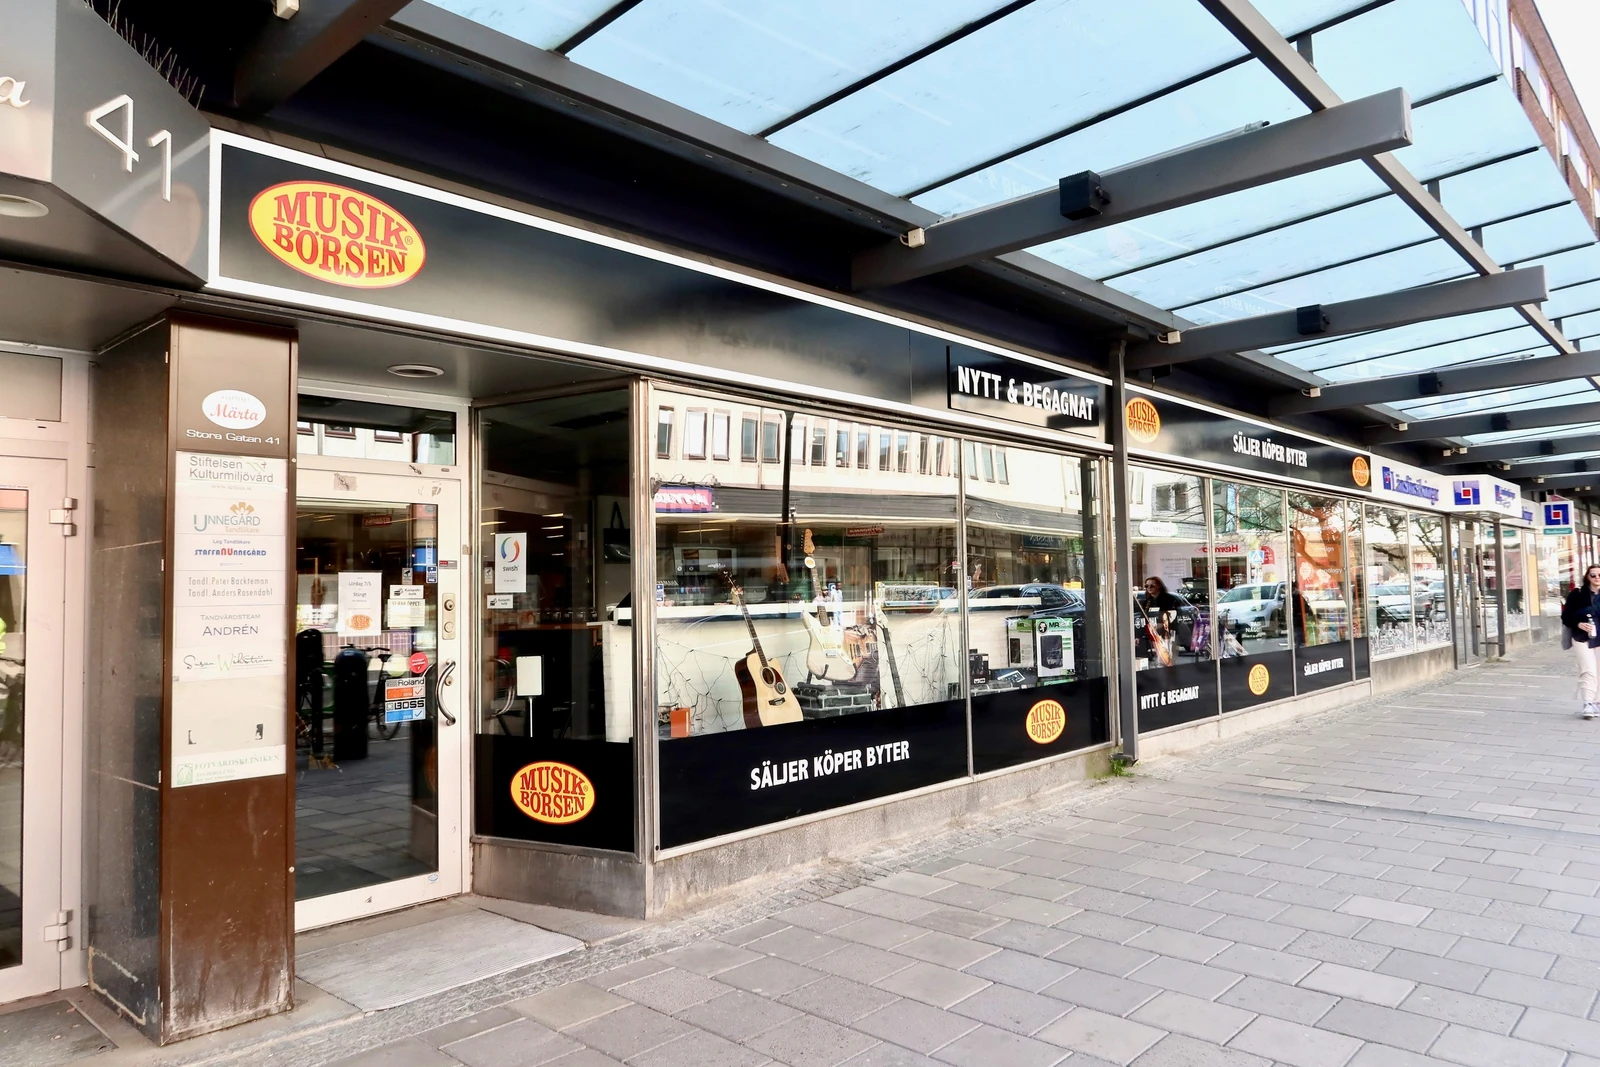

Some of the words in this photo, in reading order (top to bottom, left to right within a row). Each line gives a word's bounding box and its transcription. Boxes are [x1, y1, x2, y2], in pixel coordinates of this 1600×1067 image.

[86, 94, 172, 202] 41
[273, 191, 409, 250] MUSIK
[272, 223, 408, 279] BÖRSEN
[957, 365, 1001, 400] NYTT
[1007, 378, 1018, 404] &
[1022, 381, 1094, 421] BEGAGNAT
[209, 403, 259, 421] Märta
[1128, 401, 1156, 423] MUSIK
[186, 429, 222, 440] Stora
[225, 432, 262, 443] Gatan
[265, 436, 280, 445] 41
[1233, 431, 1260, 457] SÄLJER
[1262, 438, 1285, 463] KÖPER
[1286, 447, 1308, 467] BYTER
[189, 456, 243, 469] Stiftelsen
[189, 468, 274, 483] Kulturmiljövård
[225, 526, 260, 534] Tandläkare
[502, 564, 519, 572] swish
[212, 588, 236, 597] Anders
[200, 613, 261, 621] TANDVÅRDSTEAM
[202, 623, 259, 636] ANDRÉN
[183, 654, 215, 670] Susan
[397, 677, 425, 687] Roland
[394, 700, 425, 710] BOSS
[1140, 693, 1159, 710] NYTT
[1160, 691, 1166, 706] &
[1167, 685, 1199, 704] BEGAGNAT
[1031, 703, 1061, 724] MUSIK
[750, 758, 809, 790] SÄLJER
[813, 749, 862, 778] KÖPER
[866, 740, 910, 766] BYTER
[519, 766, 586, 795] MUSIK
[519, 790, 586, 818] BÖRSEN
